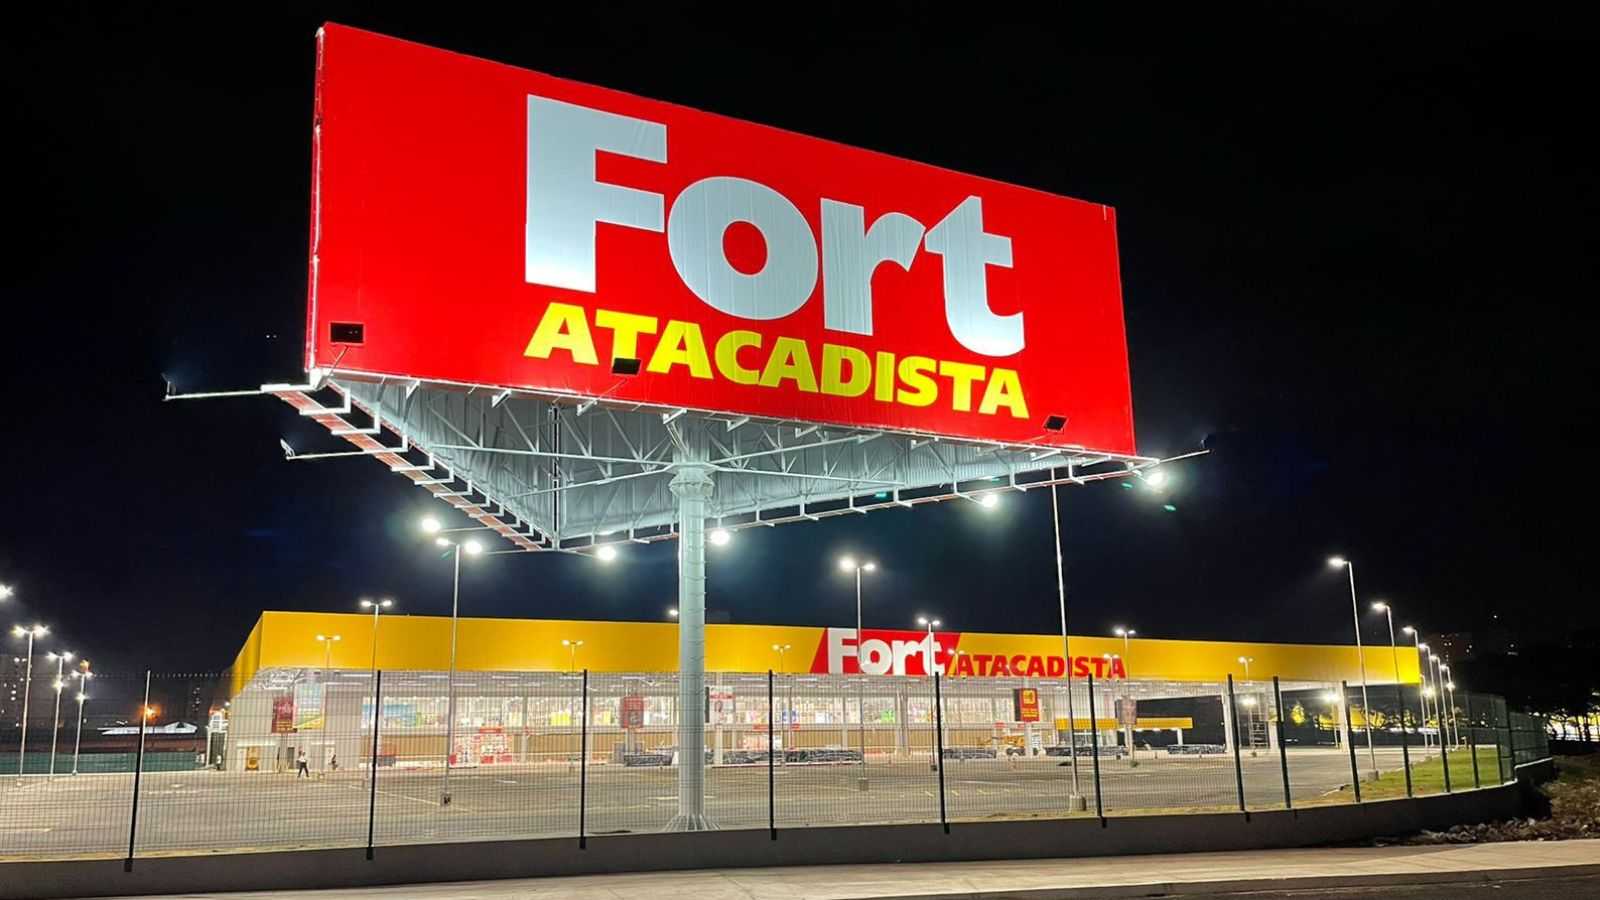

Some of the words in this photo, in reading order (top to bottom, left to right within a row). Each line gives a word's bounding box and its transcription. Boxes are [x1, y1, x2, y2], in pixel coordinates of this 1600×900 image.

[525, 94, 1024, 357] Fort
[523, 302, 1029, 419] ATACADISTA
[827, 627, 945, 676] Fort
[957, 654, 1126, 679] ATACADISTA
